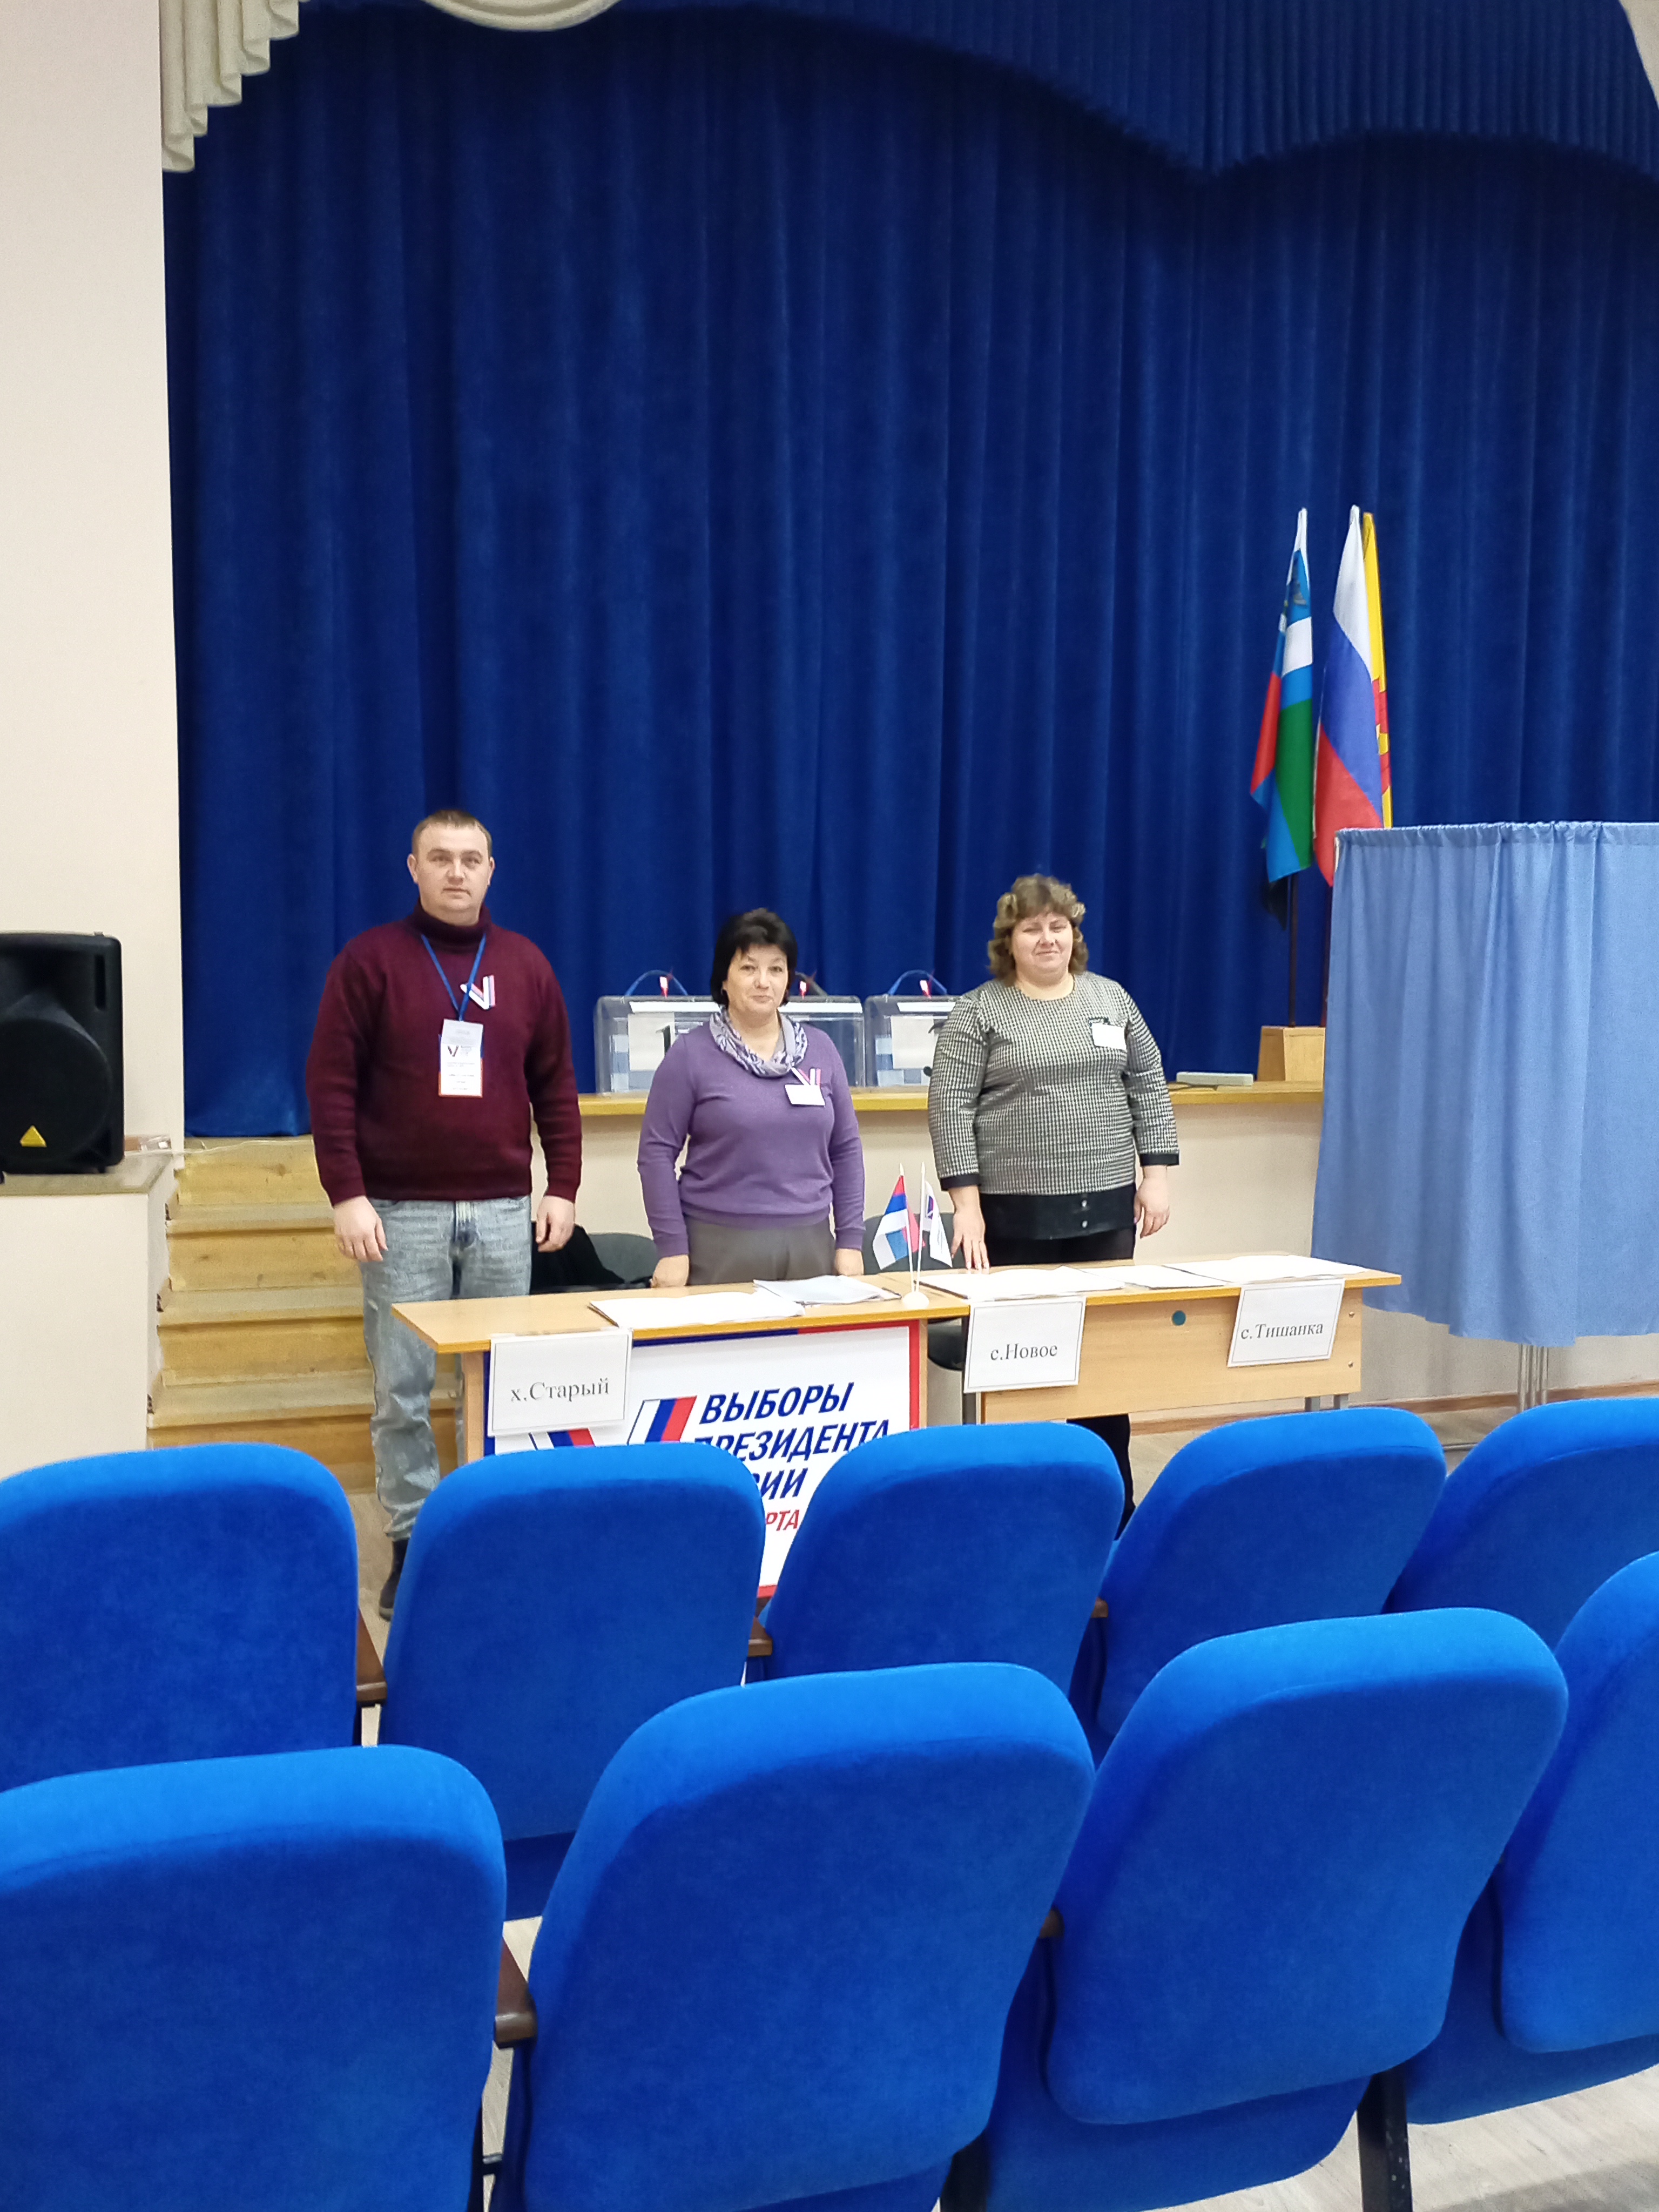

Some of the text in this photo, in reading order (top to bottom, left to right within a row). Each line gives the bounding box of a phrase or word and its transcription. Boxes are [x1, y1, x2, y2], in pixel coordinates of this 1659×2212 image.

[1240, 1323, 1324, 1340] с.Тишанка
[990, 1343, 1058, 1361] с.Новое
[510, 1377, 609, 1402] х.Старый
[699, 1381, 855, 1425] ВЫБОРЫ
[694, 1419, 889, 1462] РЕЗИДЕНТА
[752, 1467, 808, 1500] ИИ
[766, 1509, 800, 1532] РТА
